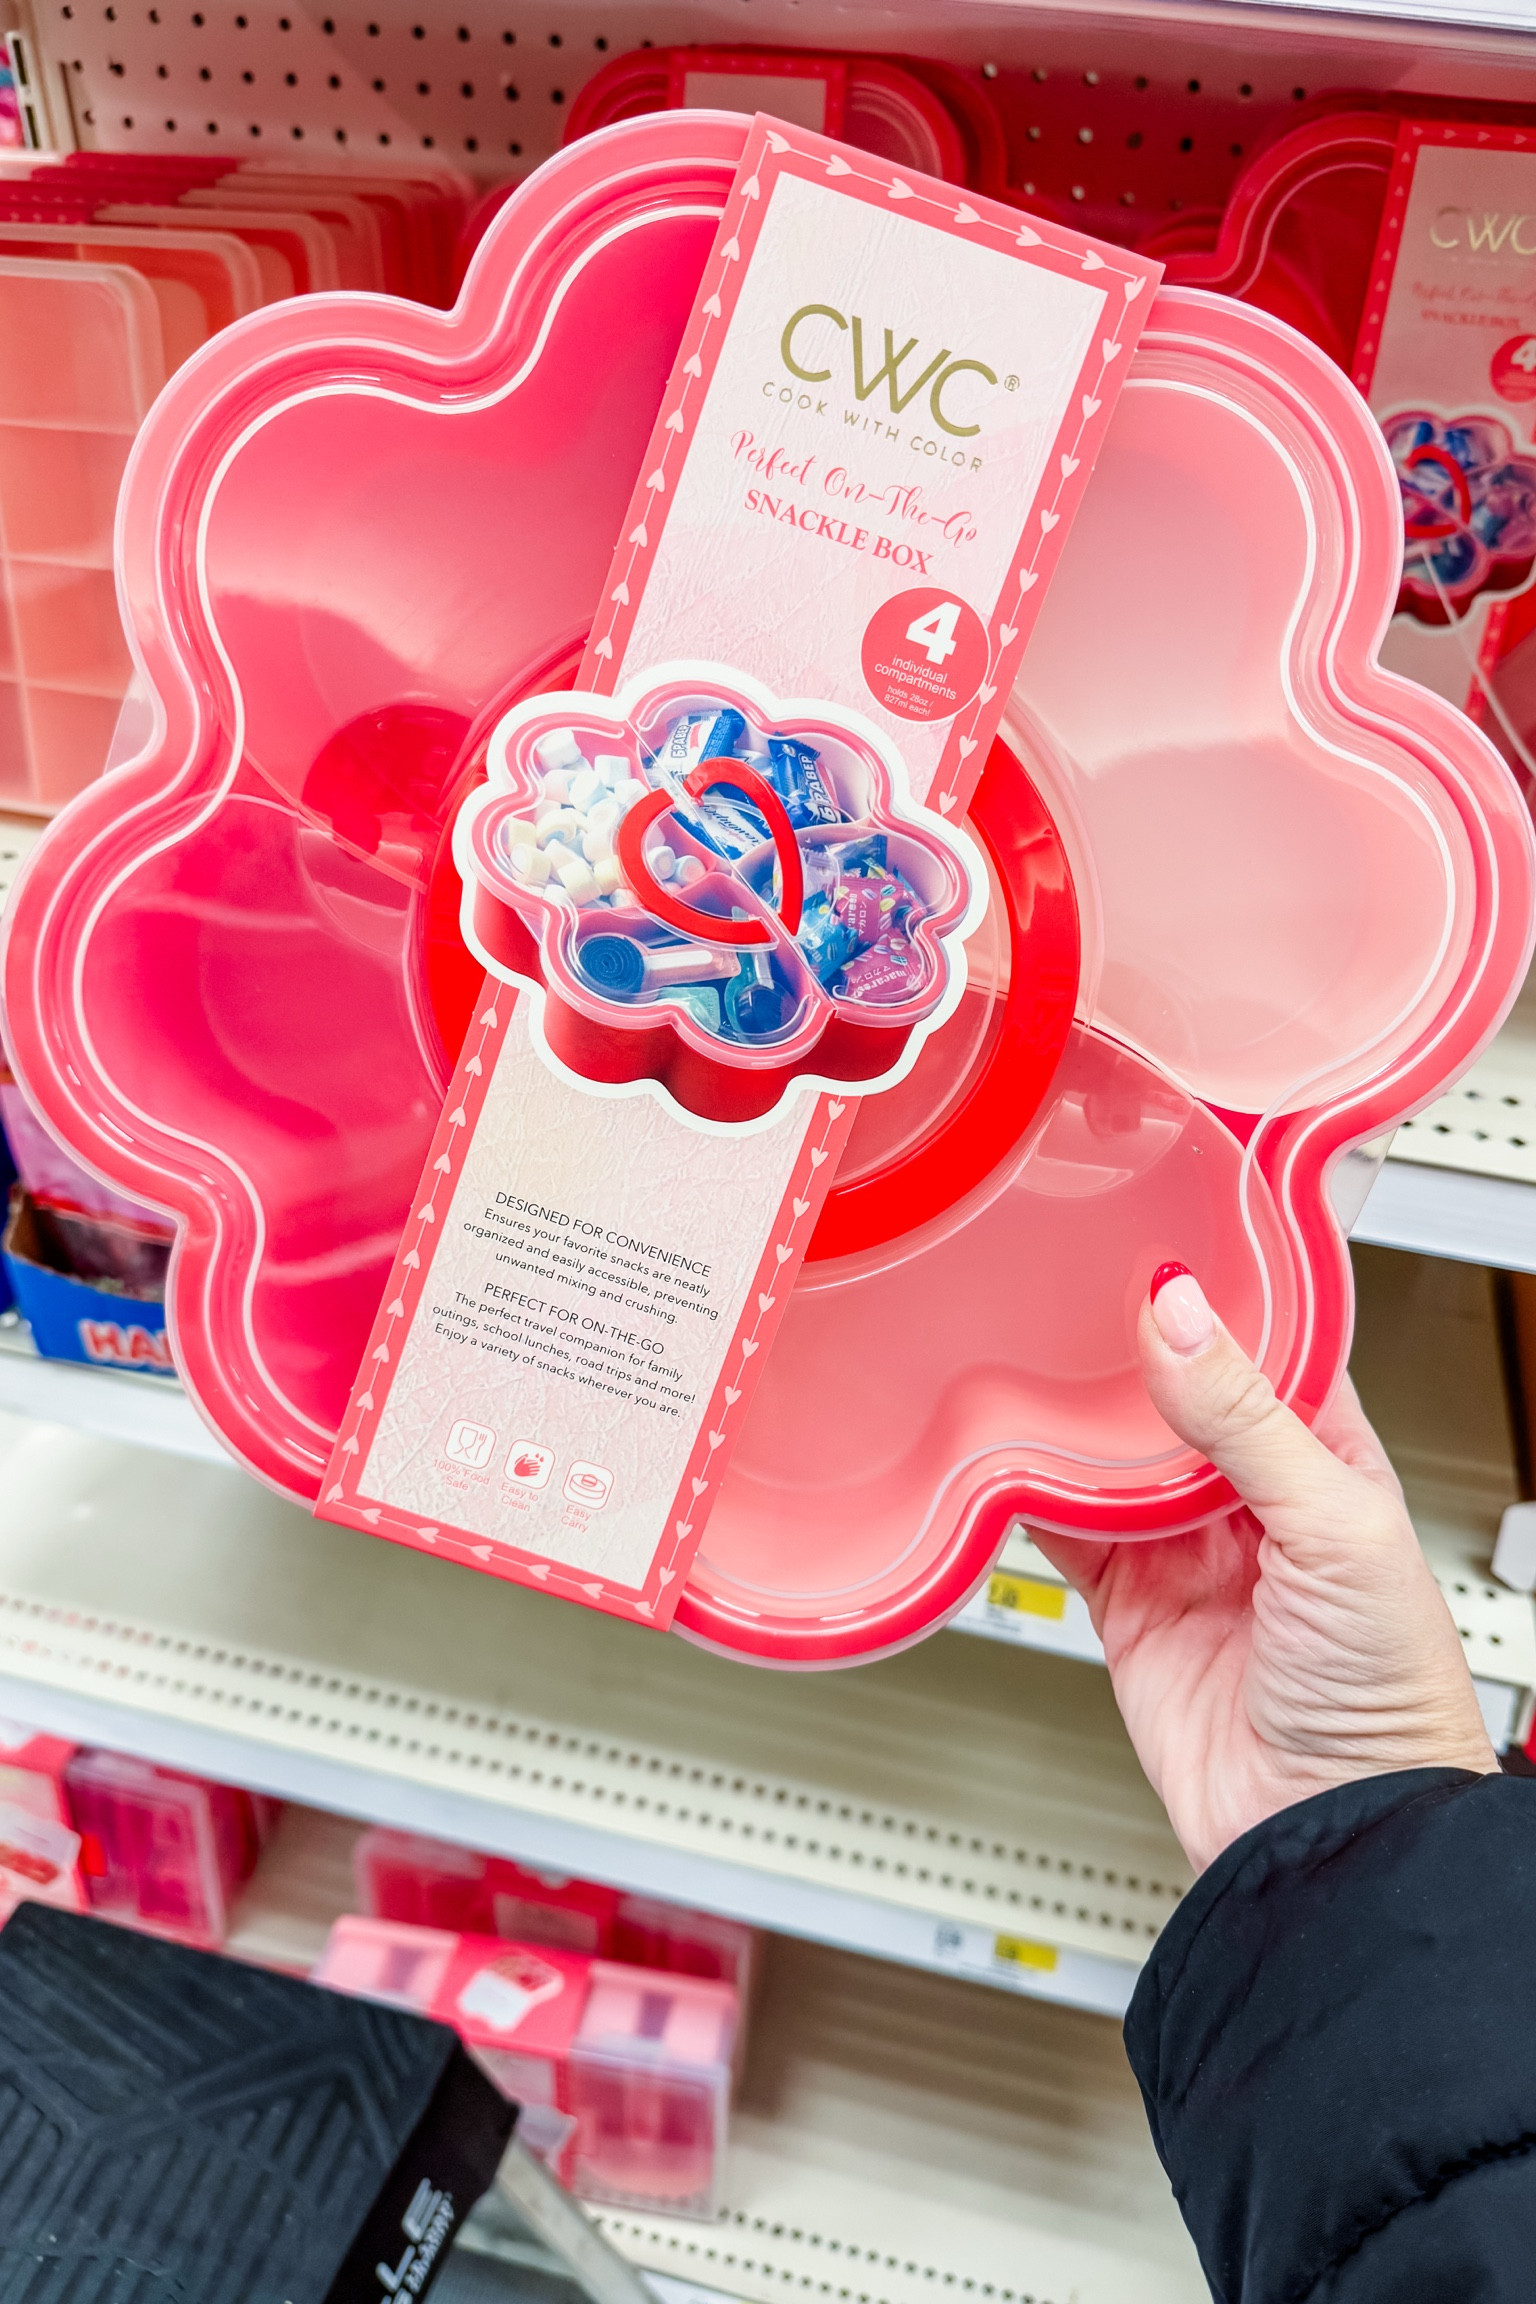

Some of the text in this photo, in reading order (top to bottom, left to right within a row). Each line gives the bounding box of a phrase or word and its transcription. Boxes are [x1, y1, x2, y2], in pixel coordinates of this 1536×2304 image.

[781, 304, 998, 437] CWC
[762, 382, 982, 472] COOK WITH COLOR
[731, 430, 977, 548] Perfect On-The-Go
[744, 489, 934, 575] SNACKLE BOX
[905, 601, 961, 665] 4
[874, 663, 957, 700] compartments
[884, 694, 908, 709] 827ml
[887, 685, 908, 699] holds
[909, 694, 928, 707] 28oz
[892, 655, 948, 684] individual
[484, 1208, 711, 1298] Ensures your favorite snacks are neatly
[495, 1191, 712, 1278] DESIGNED FOR CONVENIENCE
[463, 1222, 719, 1321] organized and easily accessible, preventing
[495, 1253, 678, 1325] unwanted mixing and crushing.
[455, 1291, 683, 1383] The perfect travel companion for family
[484, 1283, 664, 1354] PERFECT FOR ON-THE-GO
[432, 1306, 696, 1404] outings, school lunches, road trips and more!
[434, 1322, 681, 1418] Enjoy a variety of snacks wherever you are.
[433, 1459, 491, 1485] 100% Food
[445, 1476, 470, 1491] Safe
[500, 1482, 539, 1502] Easy to
[501, 1496, 531, 1512] Clean
[560, 1516, 589, 1533] Carry
[565, 1504, 592, 1521] Easy
